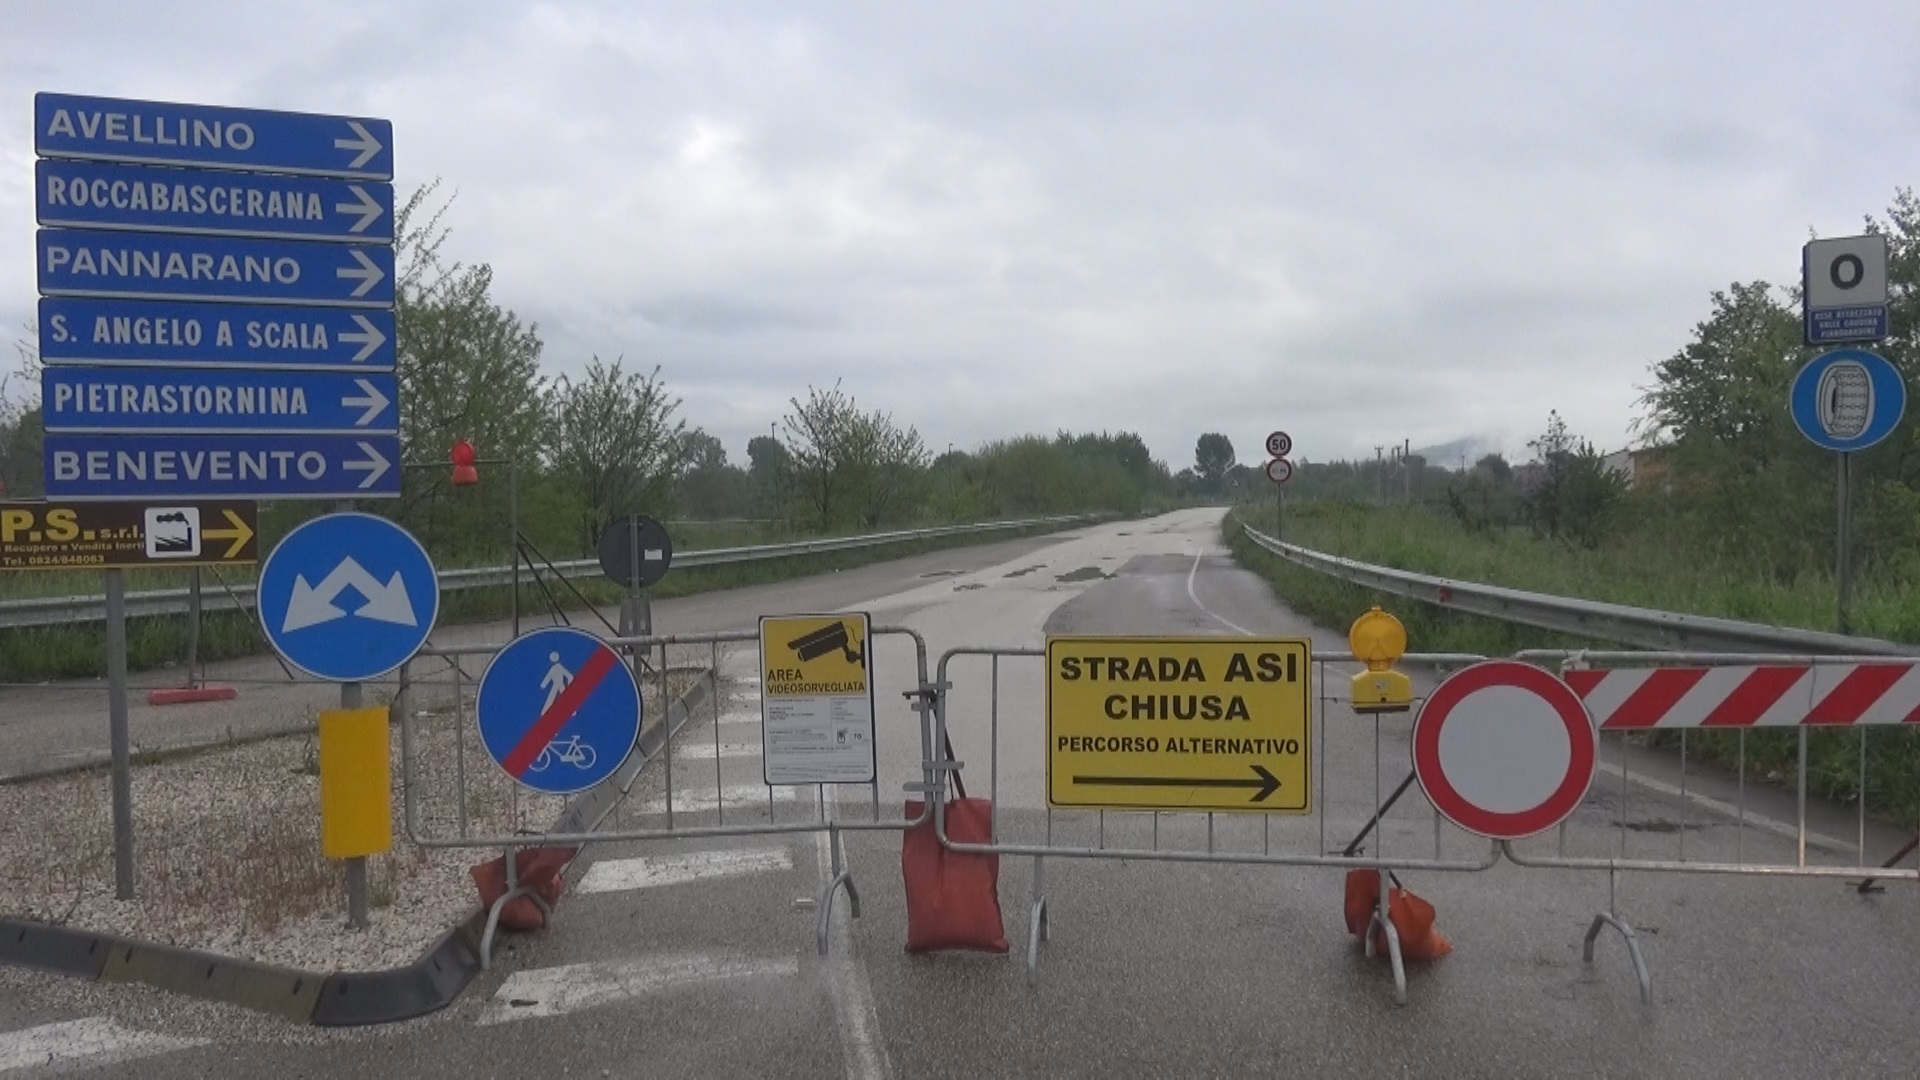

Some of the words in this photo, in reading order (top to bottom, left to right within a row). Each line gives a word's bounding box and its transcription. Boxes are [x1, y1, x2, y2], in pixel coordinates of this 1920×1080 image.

[47, 109, 255, 151] AVELLINO
[47, 176, 324, 220] ROCCABASCERANA
[47, 246, 300, 284] PANNARANO
[51, 315, 78, 343] S.
[93, 316, 201, 346] ANGELO
[216, 321, 233, 347] A
[247, 321, 328, 350] SCALA
[54, 383, 308, 415] PIETRASTORNINA
[1272, 439, 1287, 450] 50
[54, 450, 327, 481] BENEVENTO
[100, 525, 144, 538] s.r.l.
[4, 544, 58, 553] Recupero
[71, 542, 112, 551] Vendita
[115, 541, 145, 550] Inerti
[3, 556, 26, 566] Tel.
[767, 669, 803, 682] AREA
[1060, 657, 1206, 682] STRADA
[1223, 653, 1297, 682] ASI
[767, 681, 865, 694] VIDEOSORVEGLIATA
[1104, 695, 1251, 721] CHIUSA
[1057, 736, 1159, 752] PERCORSO
[1165, 737, 1299, 755] ALTERNATIVO
